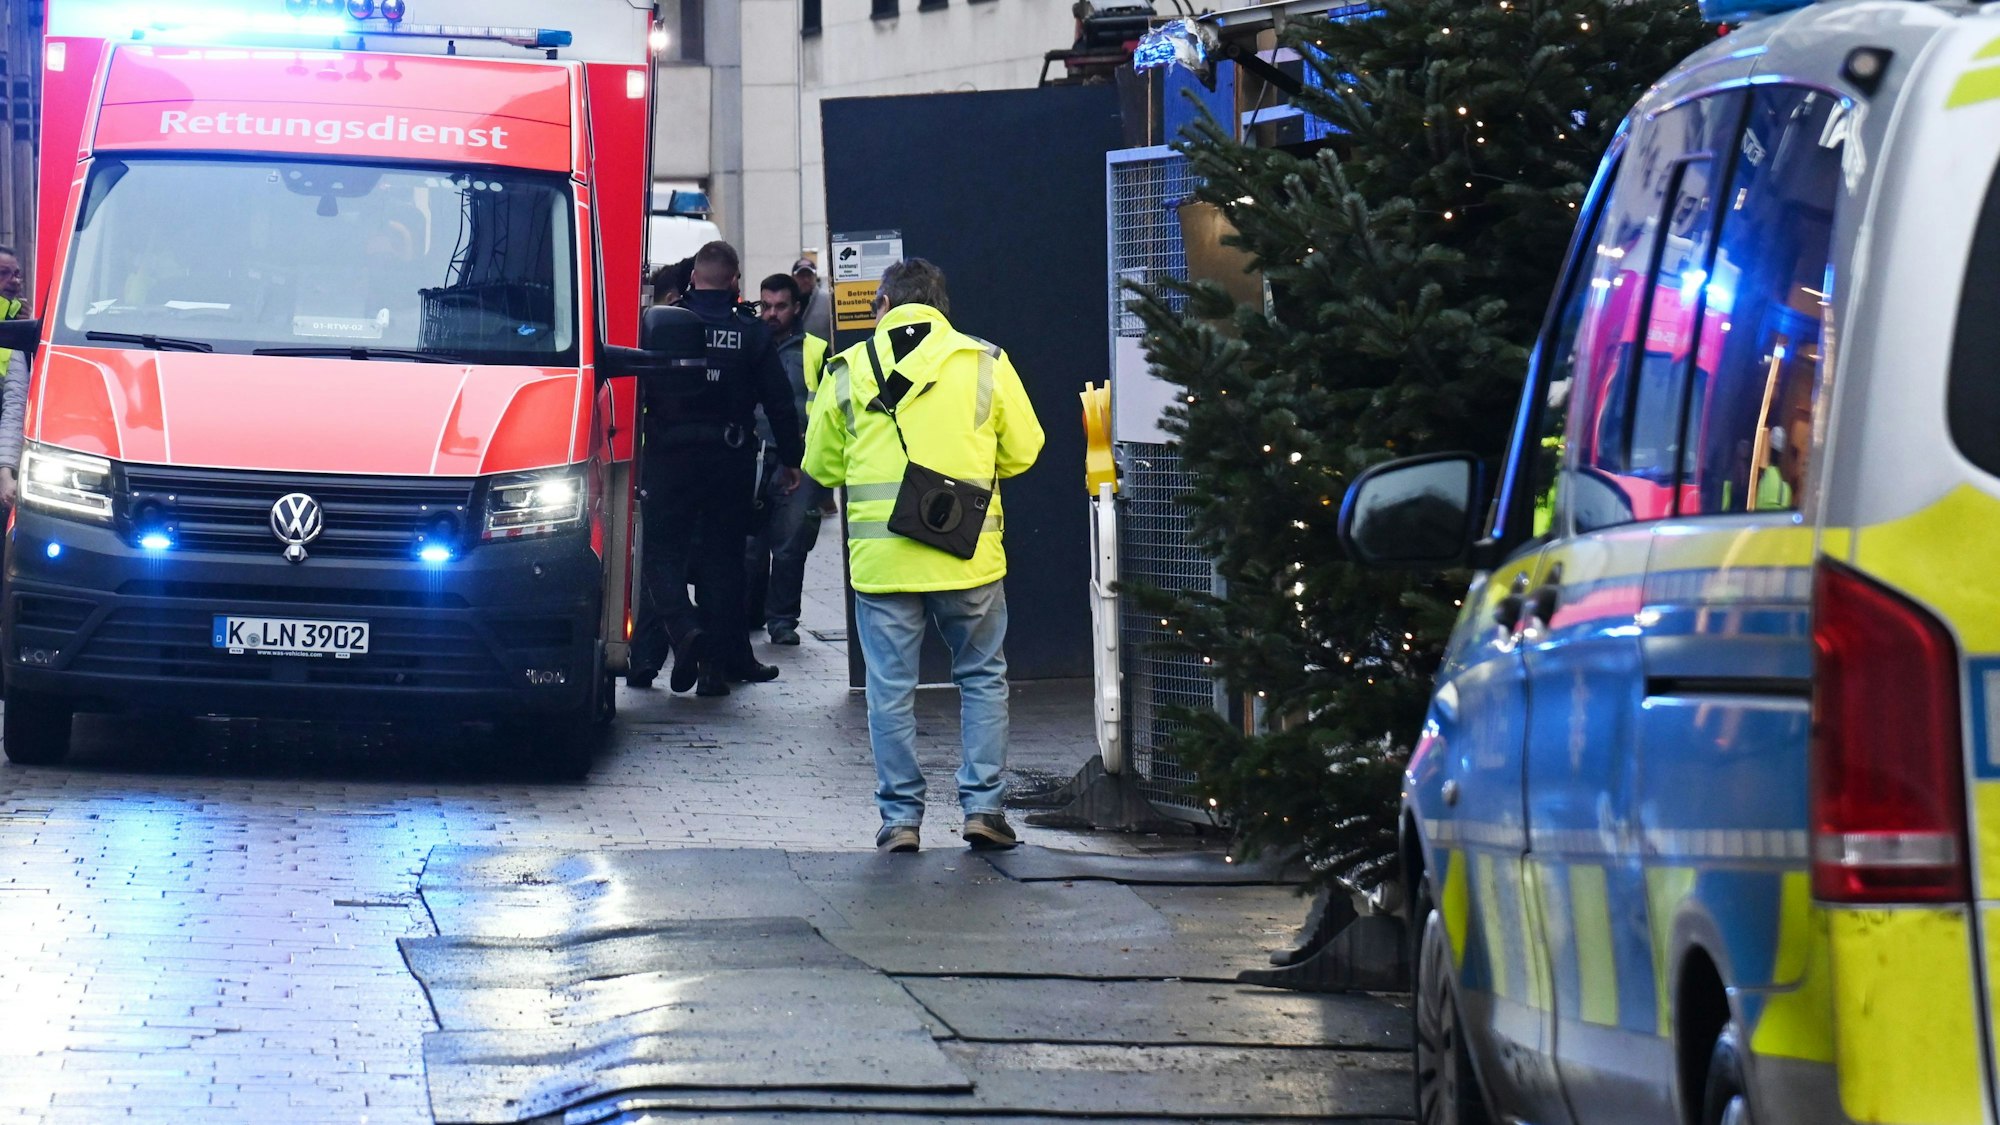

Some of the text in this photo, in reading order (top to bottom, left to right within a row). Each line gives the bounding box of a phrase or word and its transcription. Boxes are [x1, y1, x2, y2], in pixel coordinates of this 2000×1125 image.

[160, 110, 509, 149] Rettungsdienst
[313, 322, 363, 331] 01-RTW-02
[705, 329, 741, 349] LIZEI
[706, 369, 720, 381] RW
[229, 621, 365, 650] K LN 3902
[257, 650, 323, 658] www.was-vehicles.com
